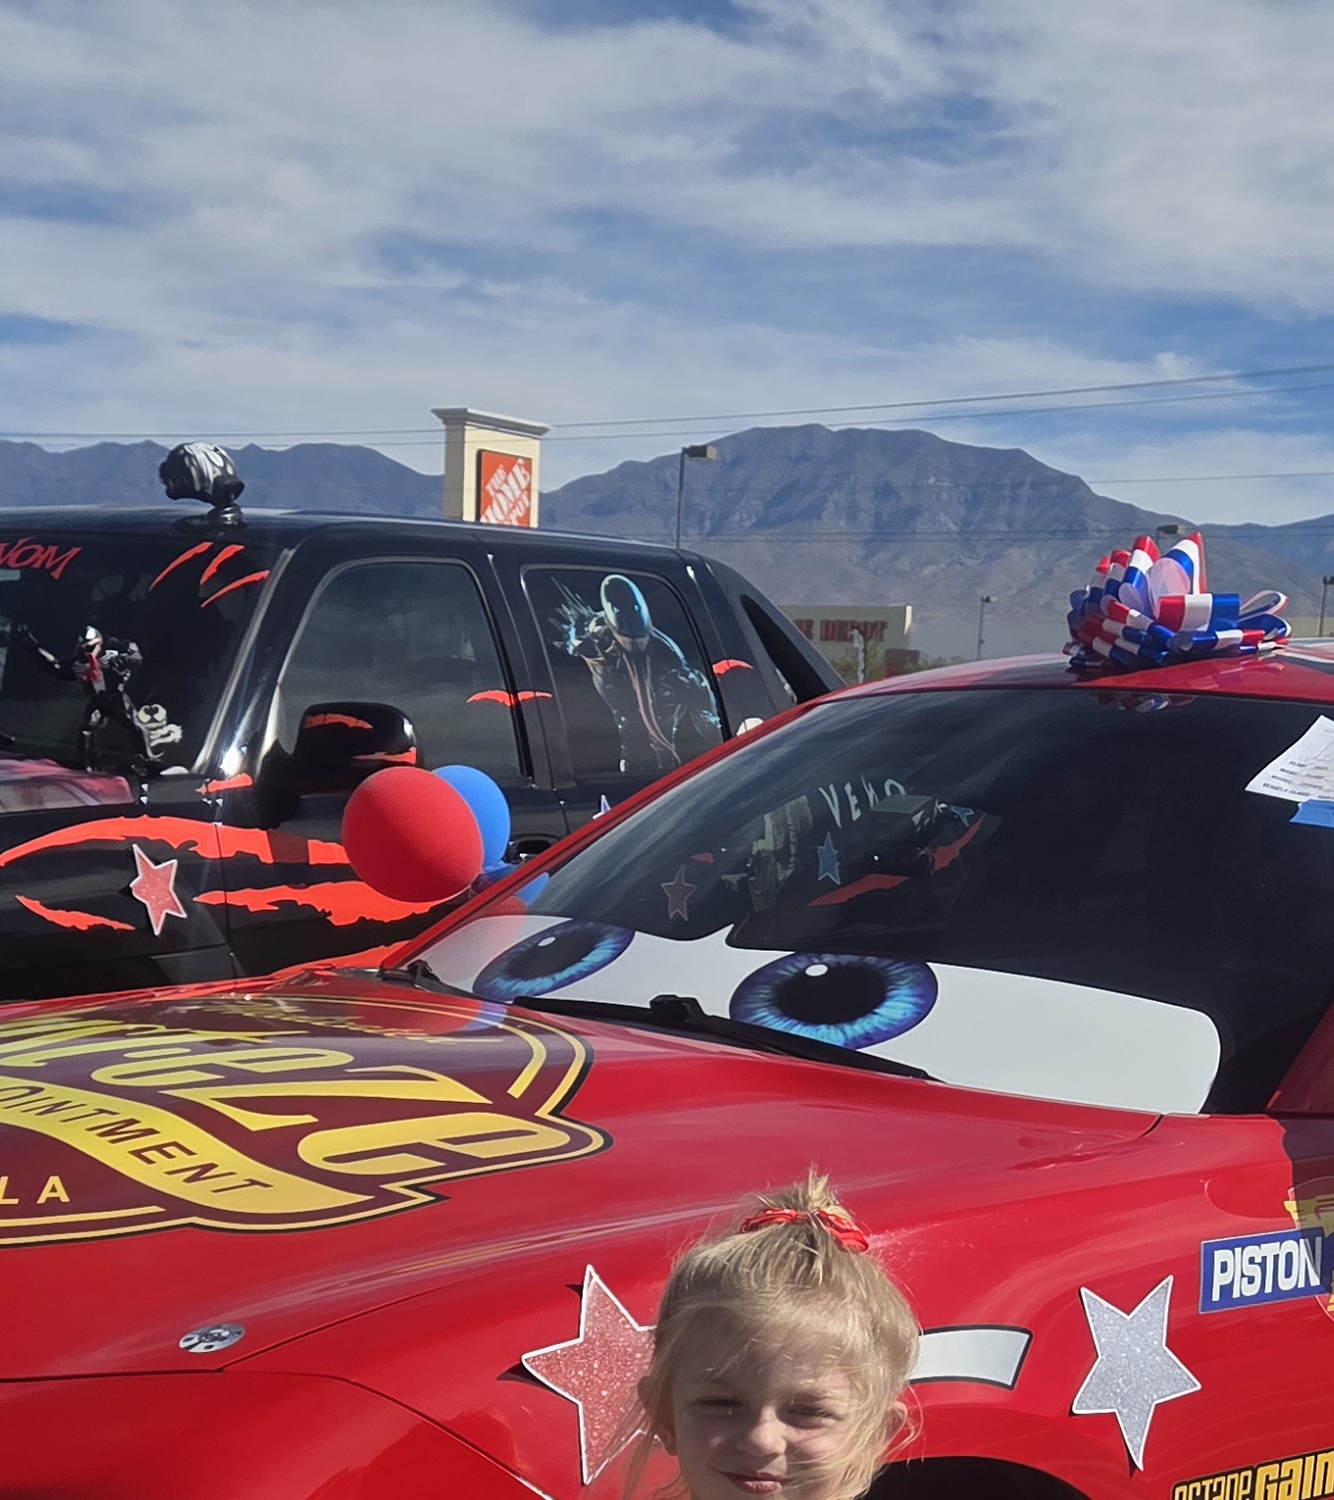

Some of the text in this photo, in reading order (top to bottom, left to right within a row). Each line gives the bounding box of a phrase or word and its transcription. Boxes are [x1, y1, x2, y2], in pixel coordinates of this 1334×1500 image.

[480, 458, 530, 523] HOME
[485, 464, 507, 497] THE
[1211, 1237, 1323, 1302] PISTON
